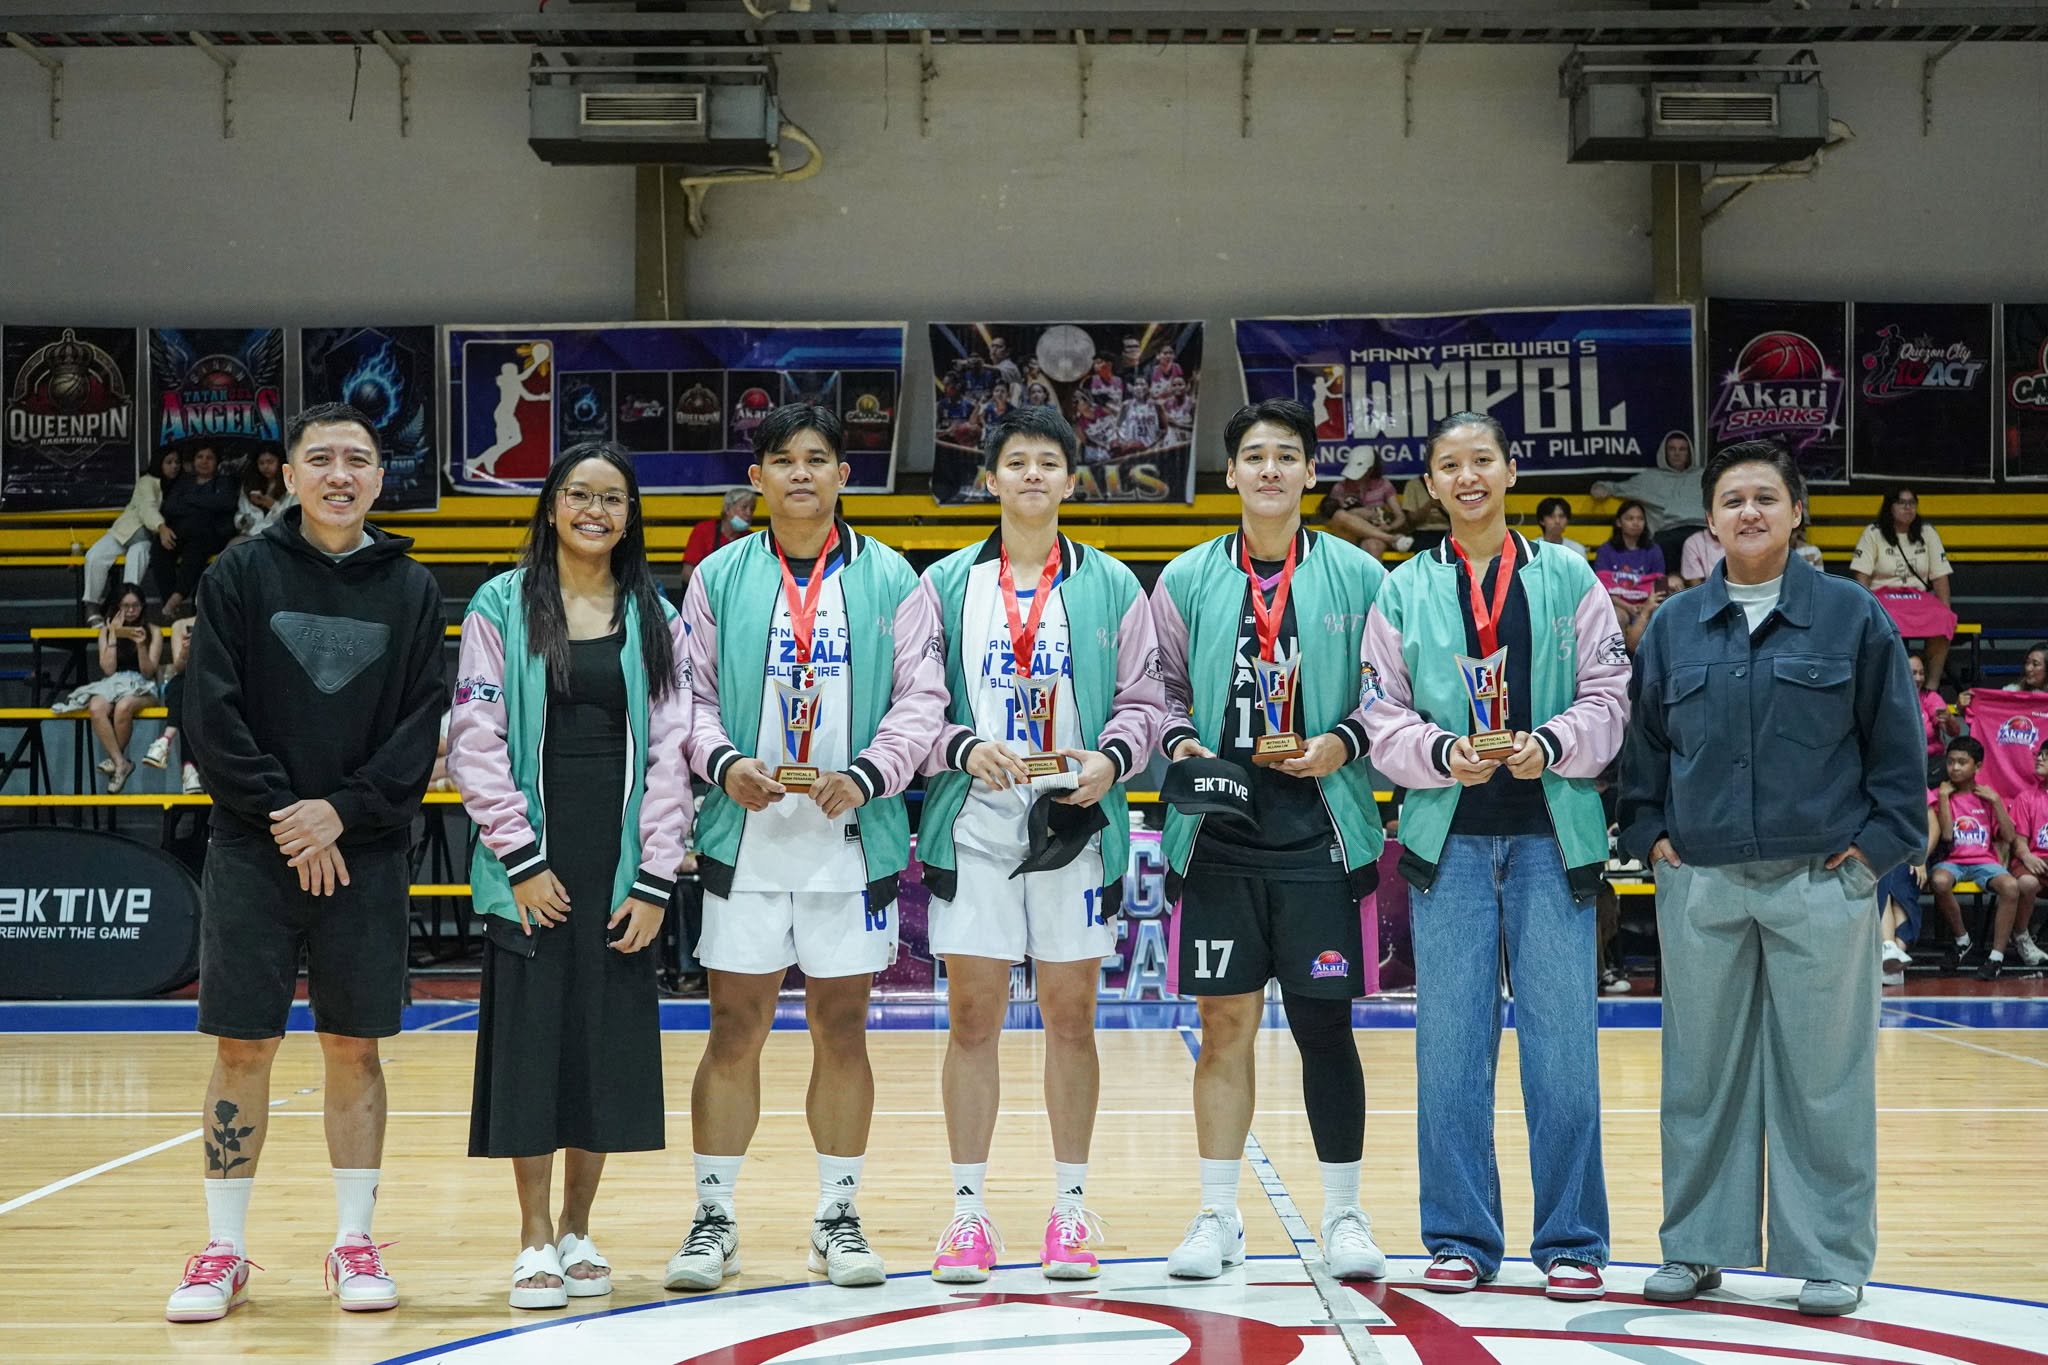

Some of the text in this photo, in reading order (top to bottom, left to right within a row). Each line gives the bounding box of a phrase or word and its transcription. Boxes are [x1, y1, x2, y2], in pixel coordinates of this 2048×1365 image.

[1351, 346, 1435, 363] MANNY
[1900, 340, 1971, 363] Quezon City
[1351, 356, 1628, 438] WMPBL
[1726, 383, 1828, 411] Akari
[10, 405, 127, 442] QUEENPIN
[160, 388, 281, 447] ANGELS
[1728, 408, 1826, 431] SPARKS
[1550, 437, 1641, 457] PILIPINA
[0, 926, 141, 939] REINVENT THE GAME
[1194, 939, 1235, 979] 17
[1315, 963, 1345, 972] Akari
